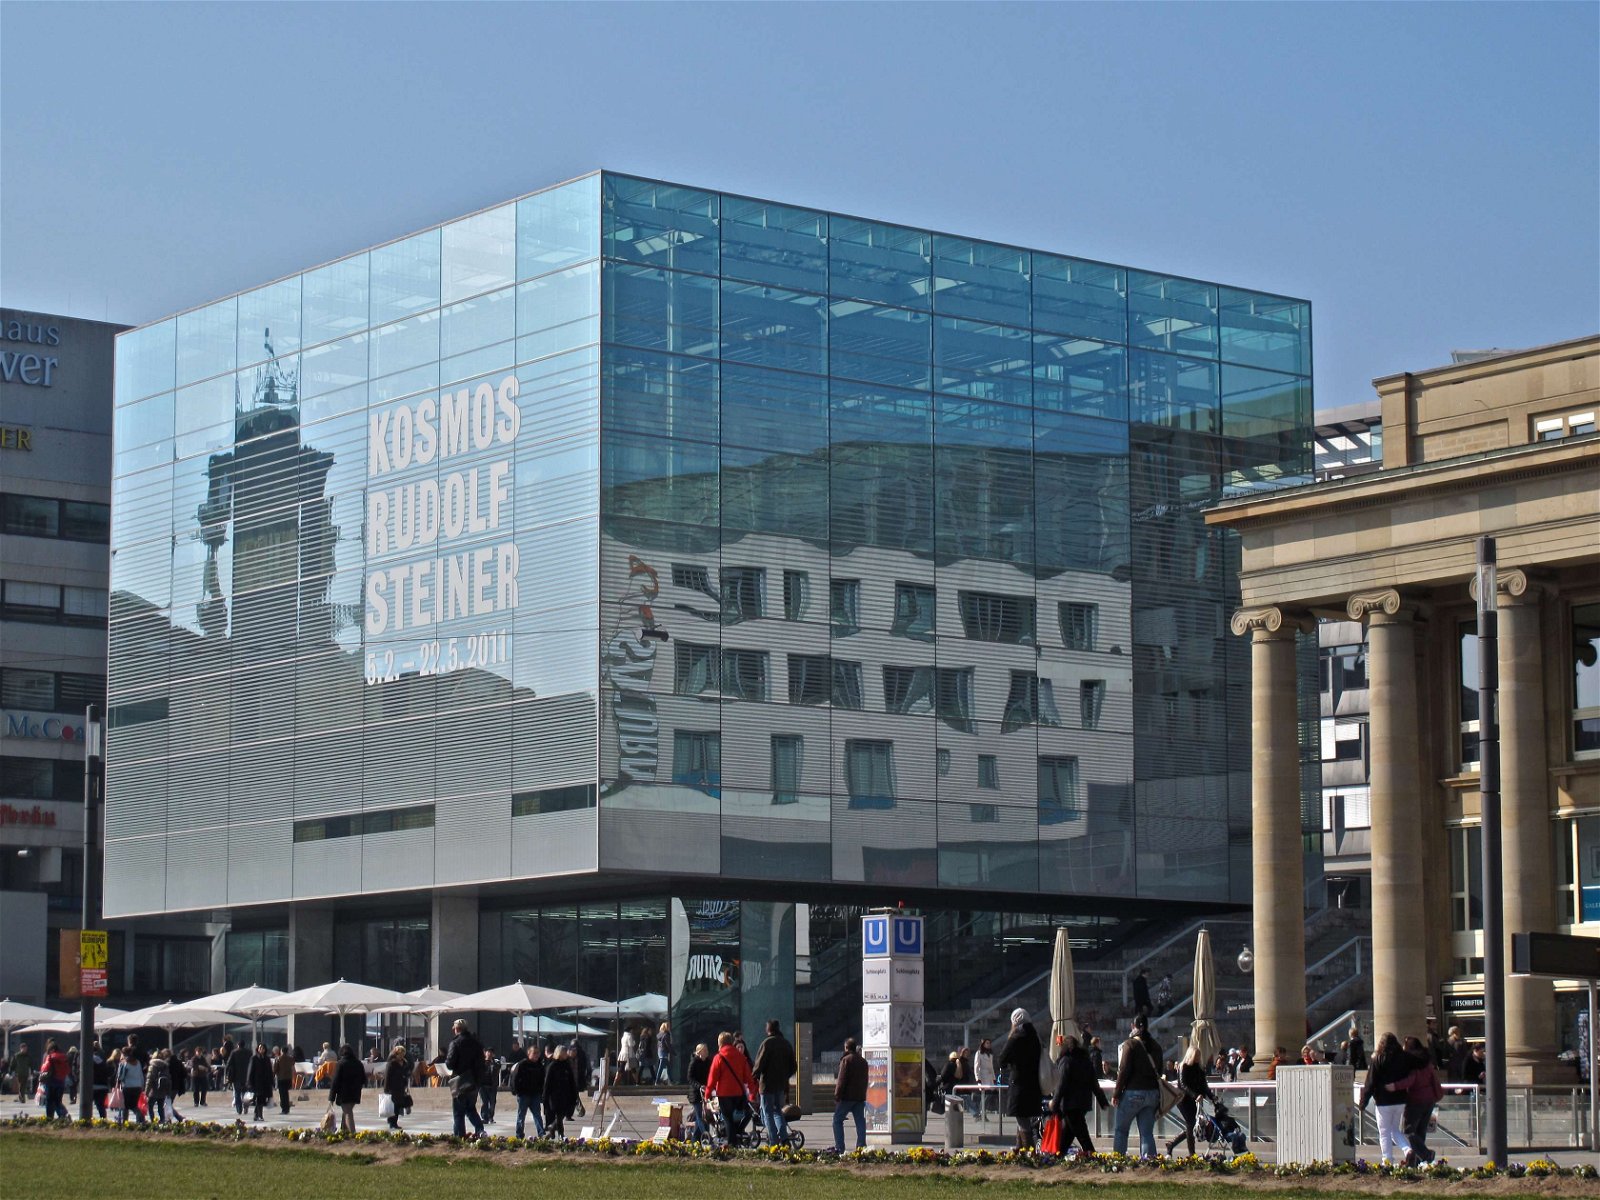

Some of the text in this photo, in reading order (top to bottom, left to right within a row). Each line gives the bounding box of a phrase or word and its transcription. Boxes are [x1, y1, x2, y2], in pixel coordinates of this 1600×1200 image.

[369, 375, 521, 477] KOSMOS
[368, 460, 510, 557] RUDOLF
[366, 542, 520, 636] STEINER
[420, 628, 507, 677] 22.5.2011
[868, 922, 884, 946] U
[900, 922, 917, 946] U
